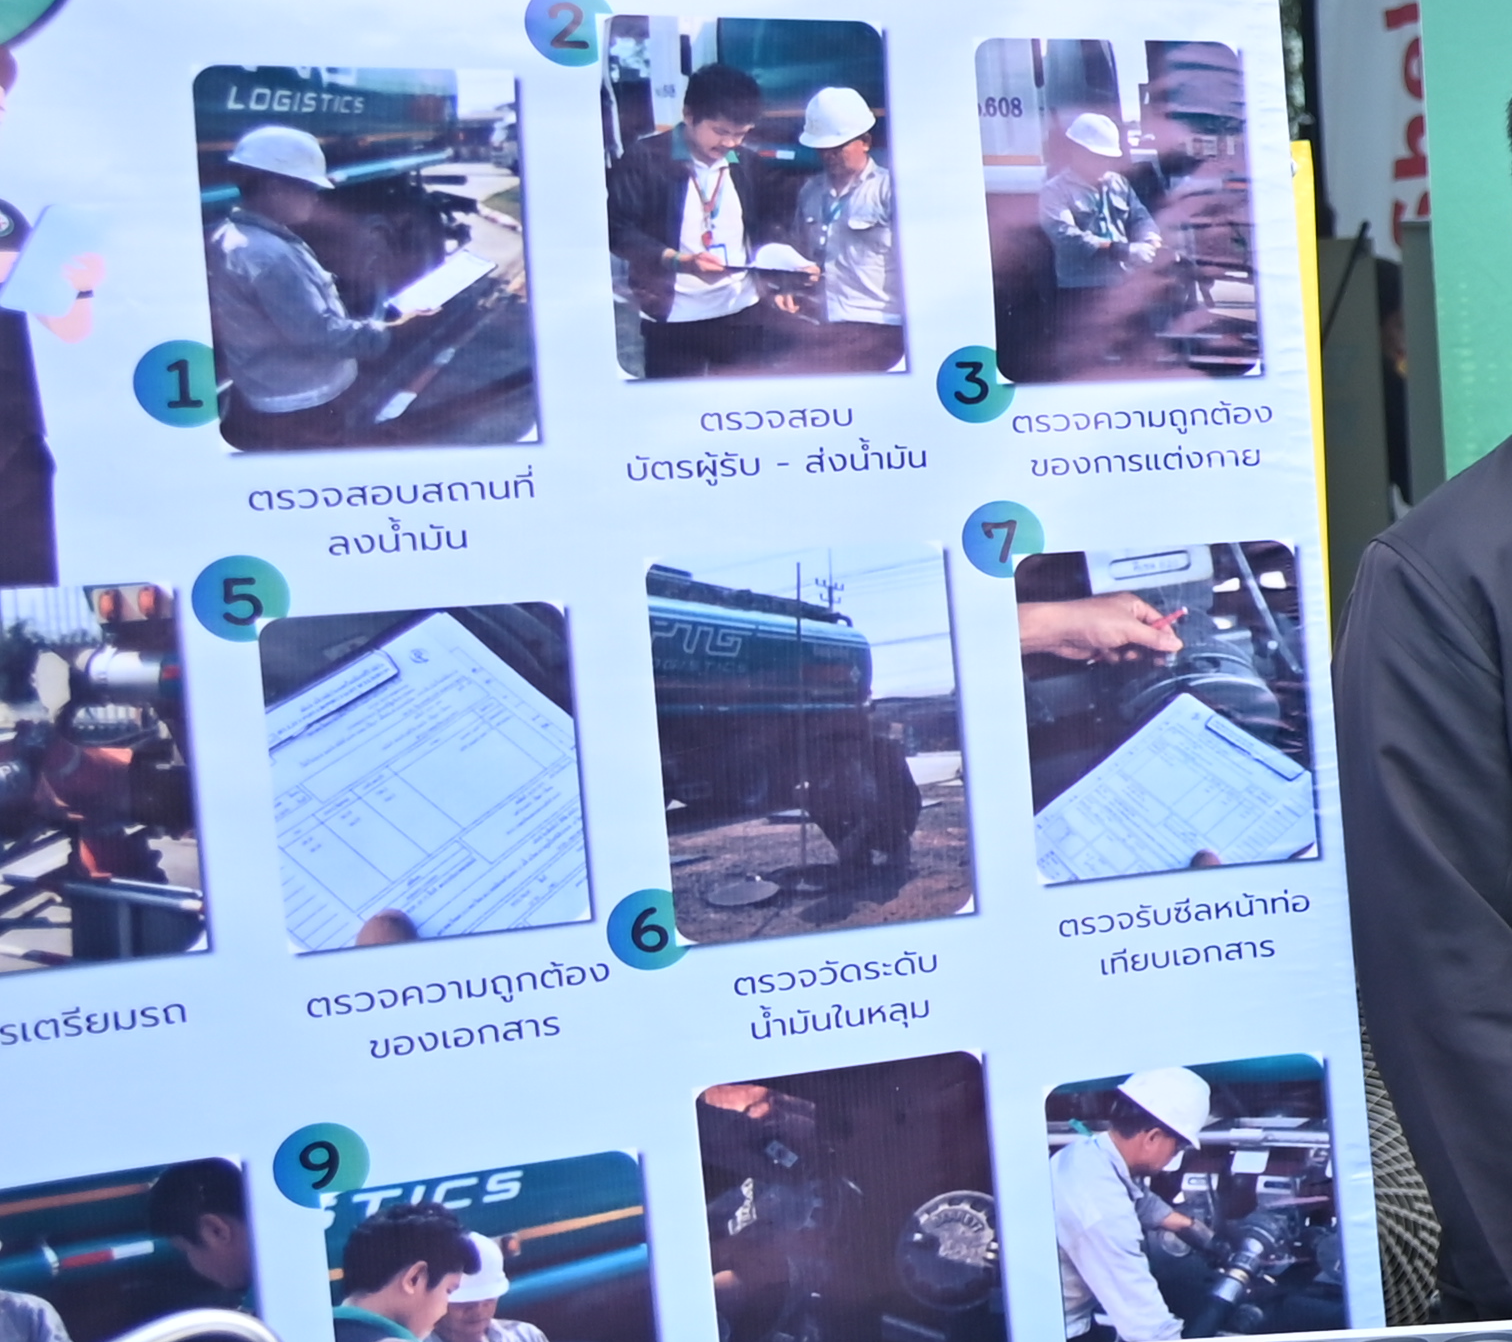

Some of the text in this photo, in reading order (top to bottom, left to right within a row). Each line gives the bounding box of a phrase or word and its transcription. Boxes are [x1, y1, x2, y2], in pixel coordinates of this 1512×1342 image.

[548, 1, 590, 50] 2
[227, 84, 365, 115] LOGISTICS
[166, 359, 204, 409] 1
[954, 361, 989, 405] 3
[700, 405, 853, 435] ตรวจสอบ
[1011, 401, 1273, 438] ตรวจความถูกต้อง
[626, 450, 761, 488] บัตรผู้รับ
[805, 438, 927, 475] ส่งน้ำมัน
[1030, 444, 1261, 479] ของการแต่งกาย
[248, 465, 536, 512] ตรวจสอบสถานที่
[328, 517, 469, 557] ลงน้ำมัน
[222, 577, 263, 625] 5
[631, 906, 669, 953] 6
[1058, 890, 1311, 939] ตรวจรับซีลหน้าท่อ
[732, 952, 938, 999] ตรวจวัดระดับ
[1100, 935, 1275, 978] เทียบเอกสาร
[306, 959, 611, 1019] ตรวจความถูกต้อง
[369, 1012, 562, 1059] ของเอกสาร
[750, 996, 930, 1040] น้ำมันในหลุม
[299, 1141, 341, 1190] 9
